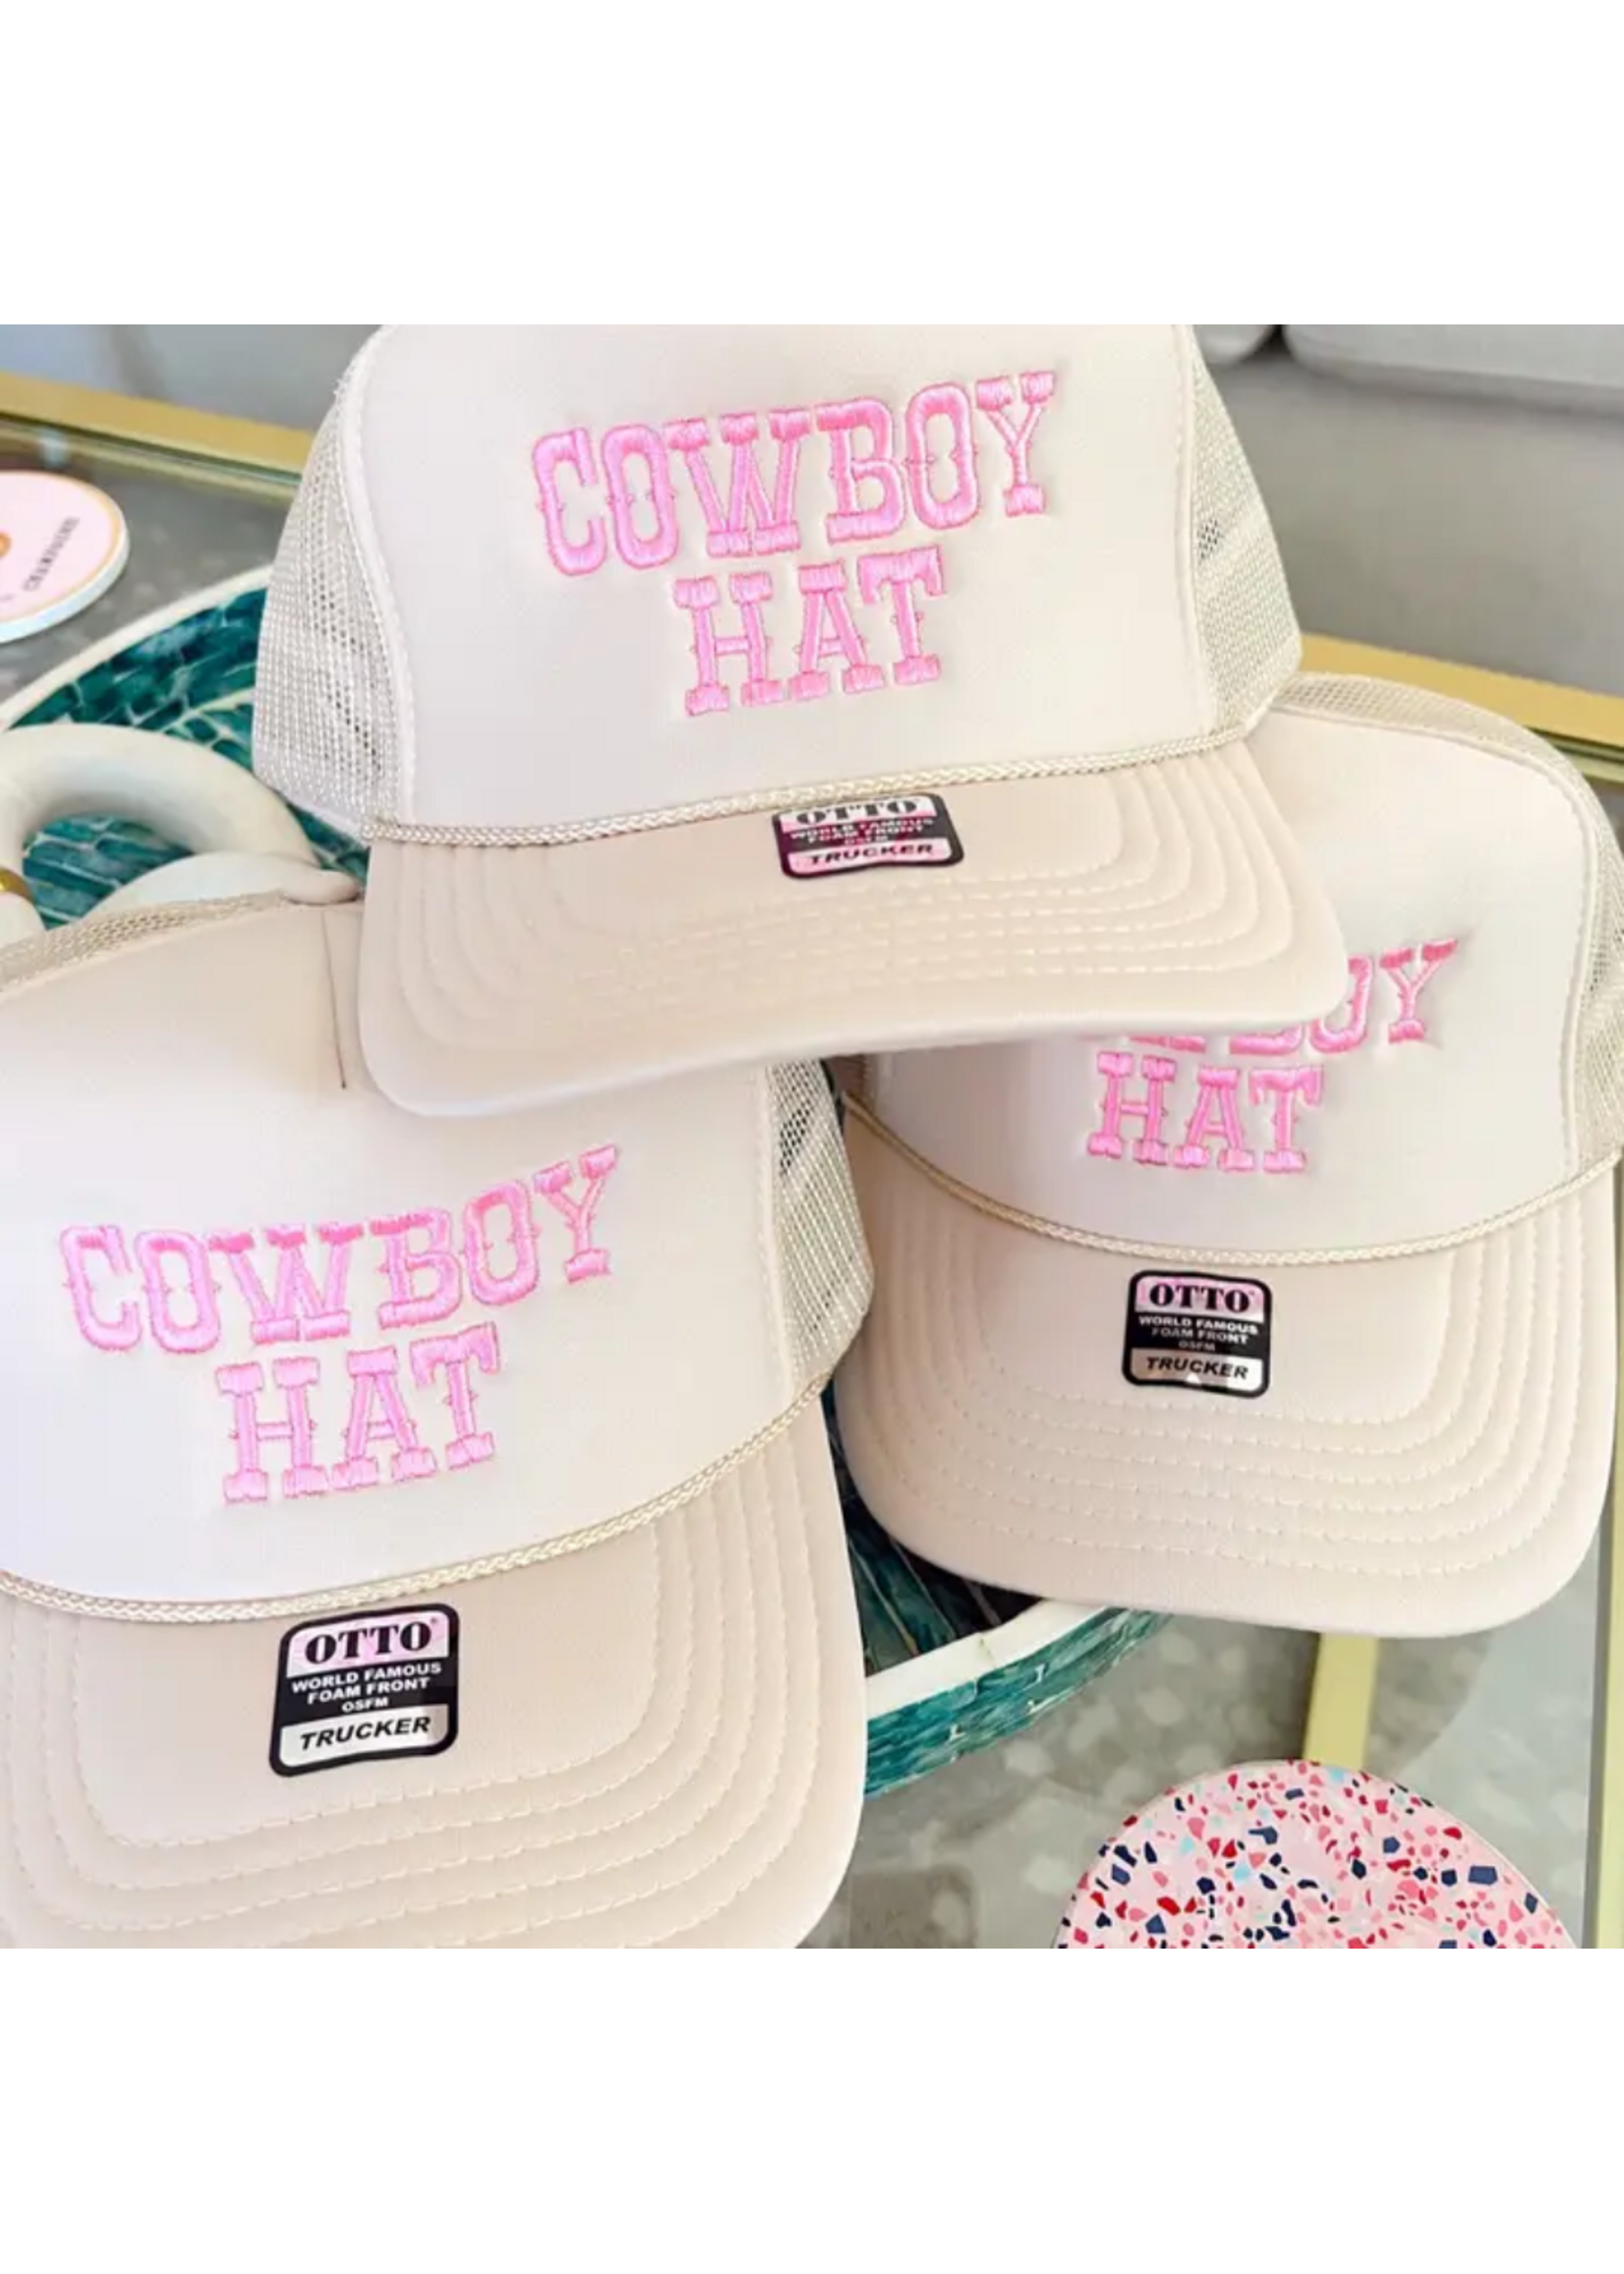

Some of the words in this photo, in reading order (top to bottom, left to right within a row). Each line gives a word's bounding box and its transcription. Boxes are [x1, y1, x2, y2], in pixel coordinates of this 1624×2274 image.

[532, 370, 1057, 577] COWBOY
[671, 544, 944, 717] HAT
[810, 843, 935, 866] TRUCKER
[1087, 1049, 1324, 1175] HAT
[59, 1143, 618, 1355] COWBOY
[1149, 1283, 1250, 1313] OTTO
[1138, 1314, 1191, 1327] WORLD
[1195, 1319, 1258, 1335] FAMOUS
[1151, 1327, 1193, 1338] FOAM
[1197, 1329, 1249, 1345] FRONT
[1146, 1356, 1249, 1380] TRUCKER
[214, 1320, 500, 1505] HAT
[305, 1621, 433, 1665] OTTO
[291, 1671, 359, 1693] WORLD
[364, 1662, 442, 1682] FAMOUS
[307, 1684, 362, 1706] FOAM
[366, 1676, 432, 1696] FRONT
[341, 1696, 389, 1714] OSFM
[300, 1716, 433, 1751] TRUCKER
